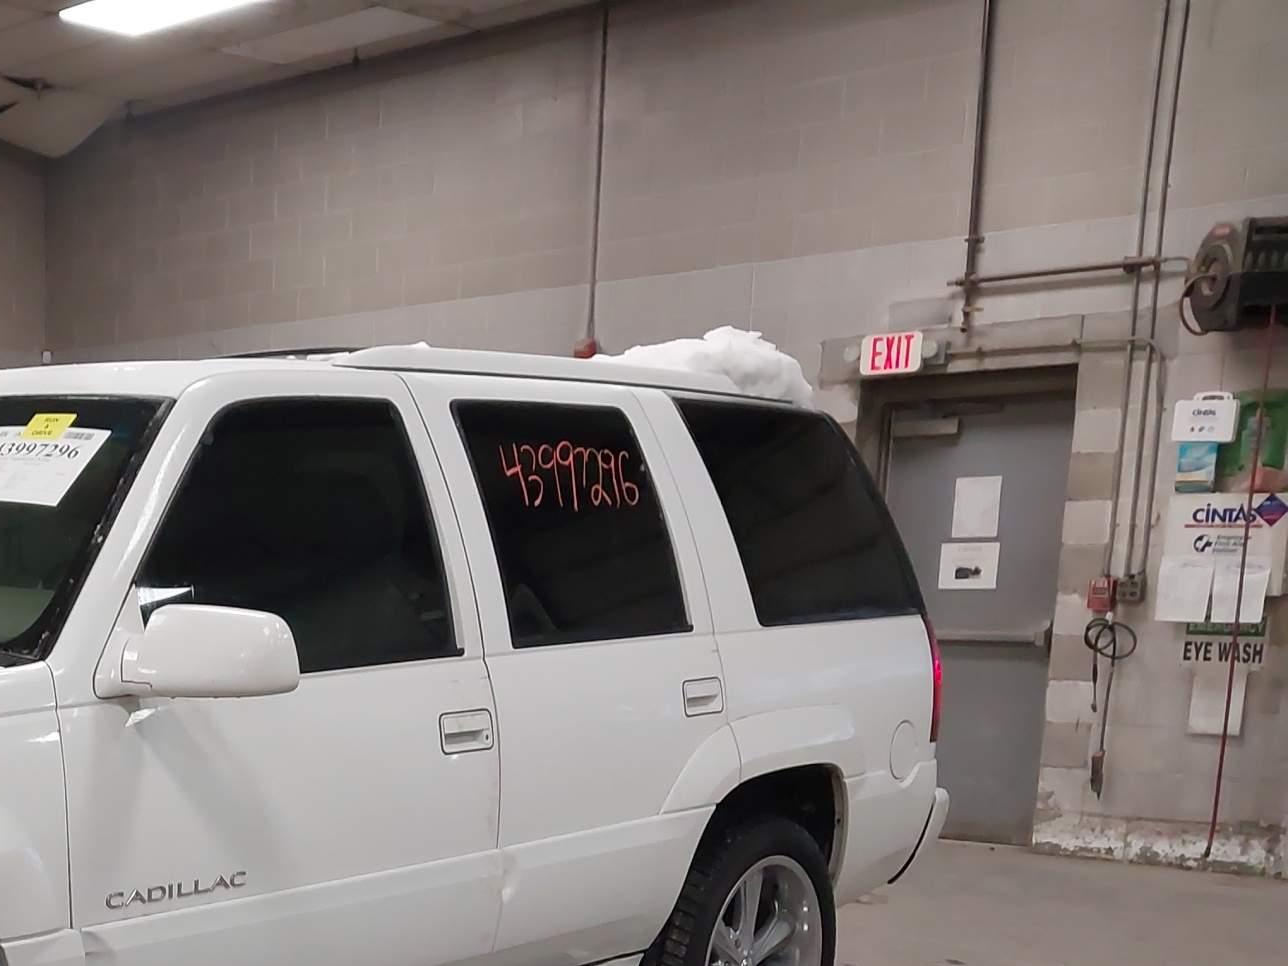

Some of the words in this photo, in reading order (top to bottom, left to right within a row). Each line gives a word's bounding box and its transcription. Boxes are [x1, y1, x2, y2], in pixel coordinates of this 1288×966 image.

[871, 334, 915, 371] EXIT
[498, 440, 639, 513] 43997296
[1192, 502, 1258, 524] CINTAS
[1183, 641, 1213, 661] EYE
[1218, 641, 1264, 664] WASH
[105, 870, 248, 909] CADILLAC
